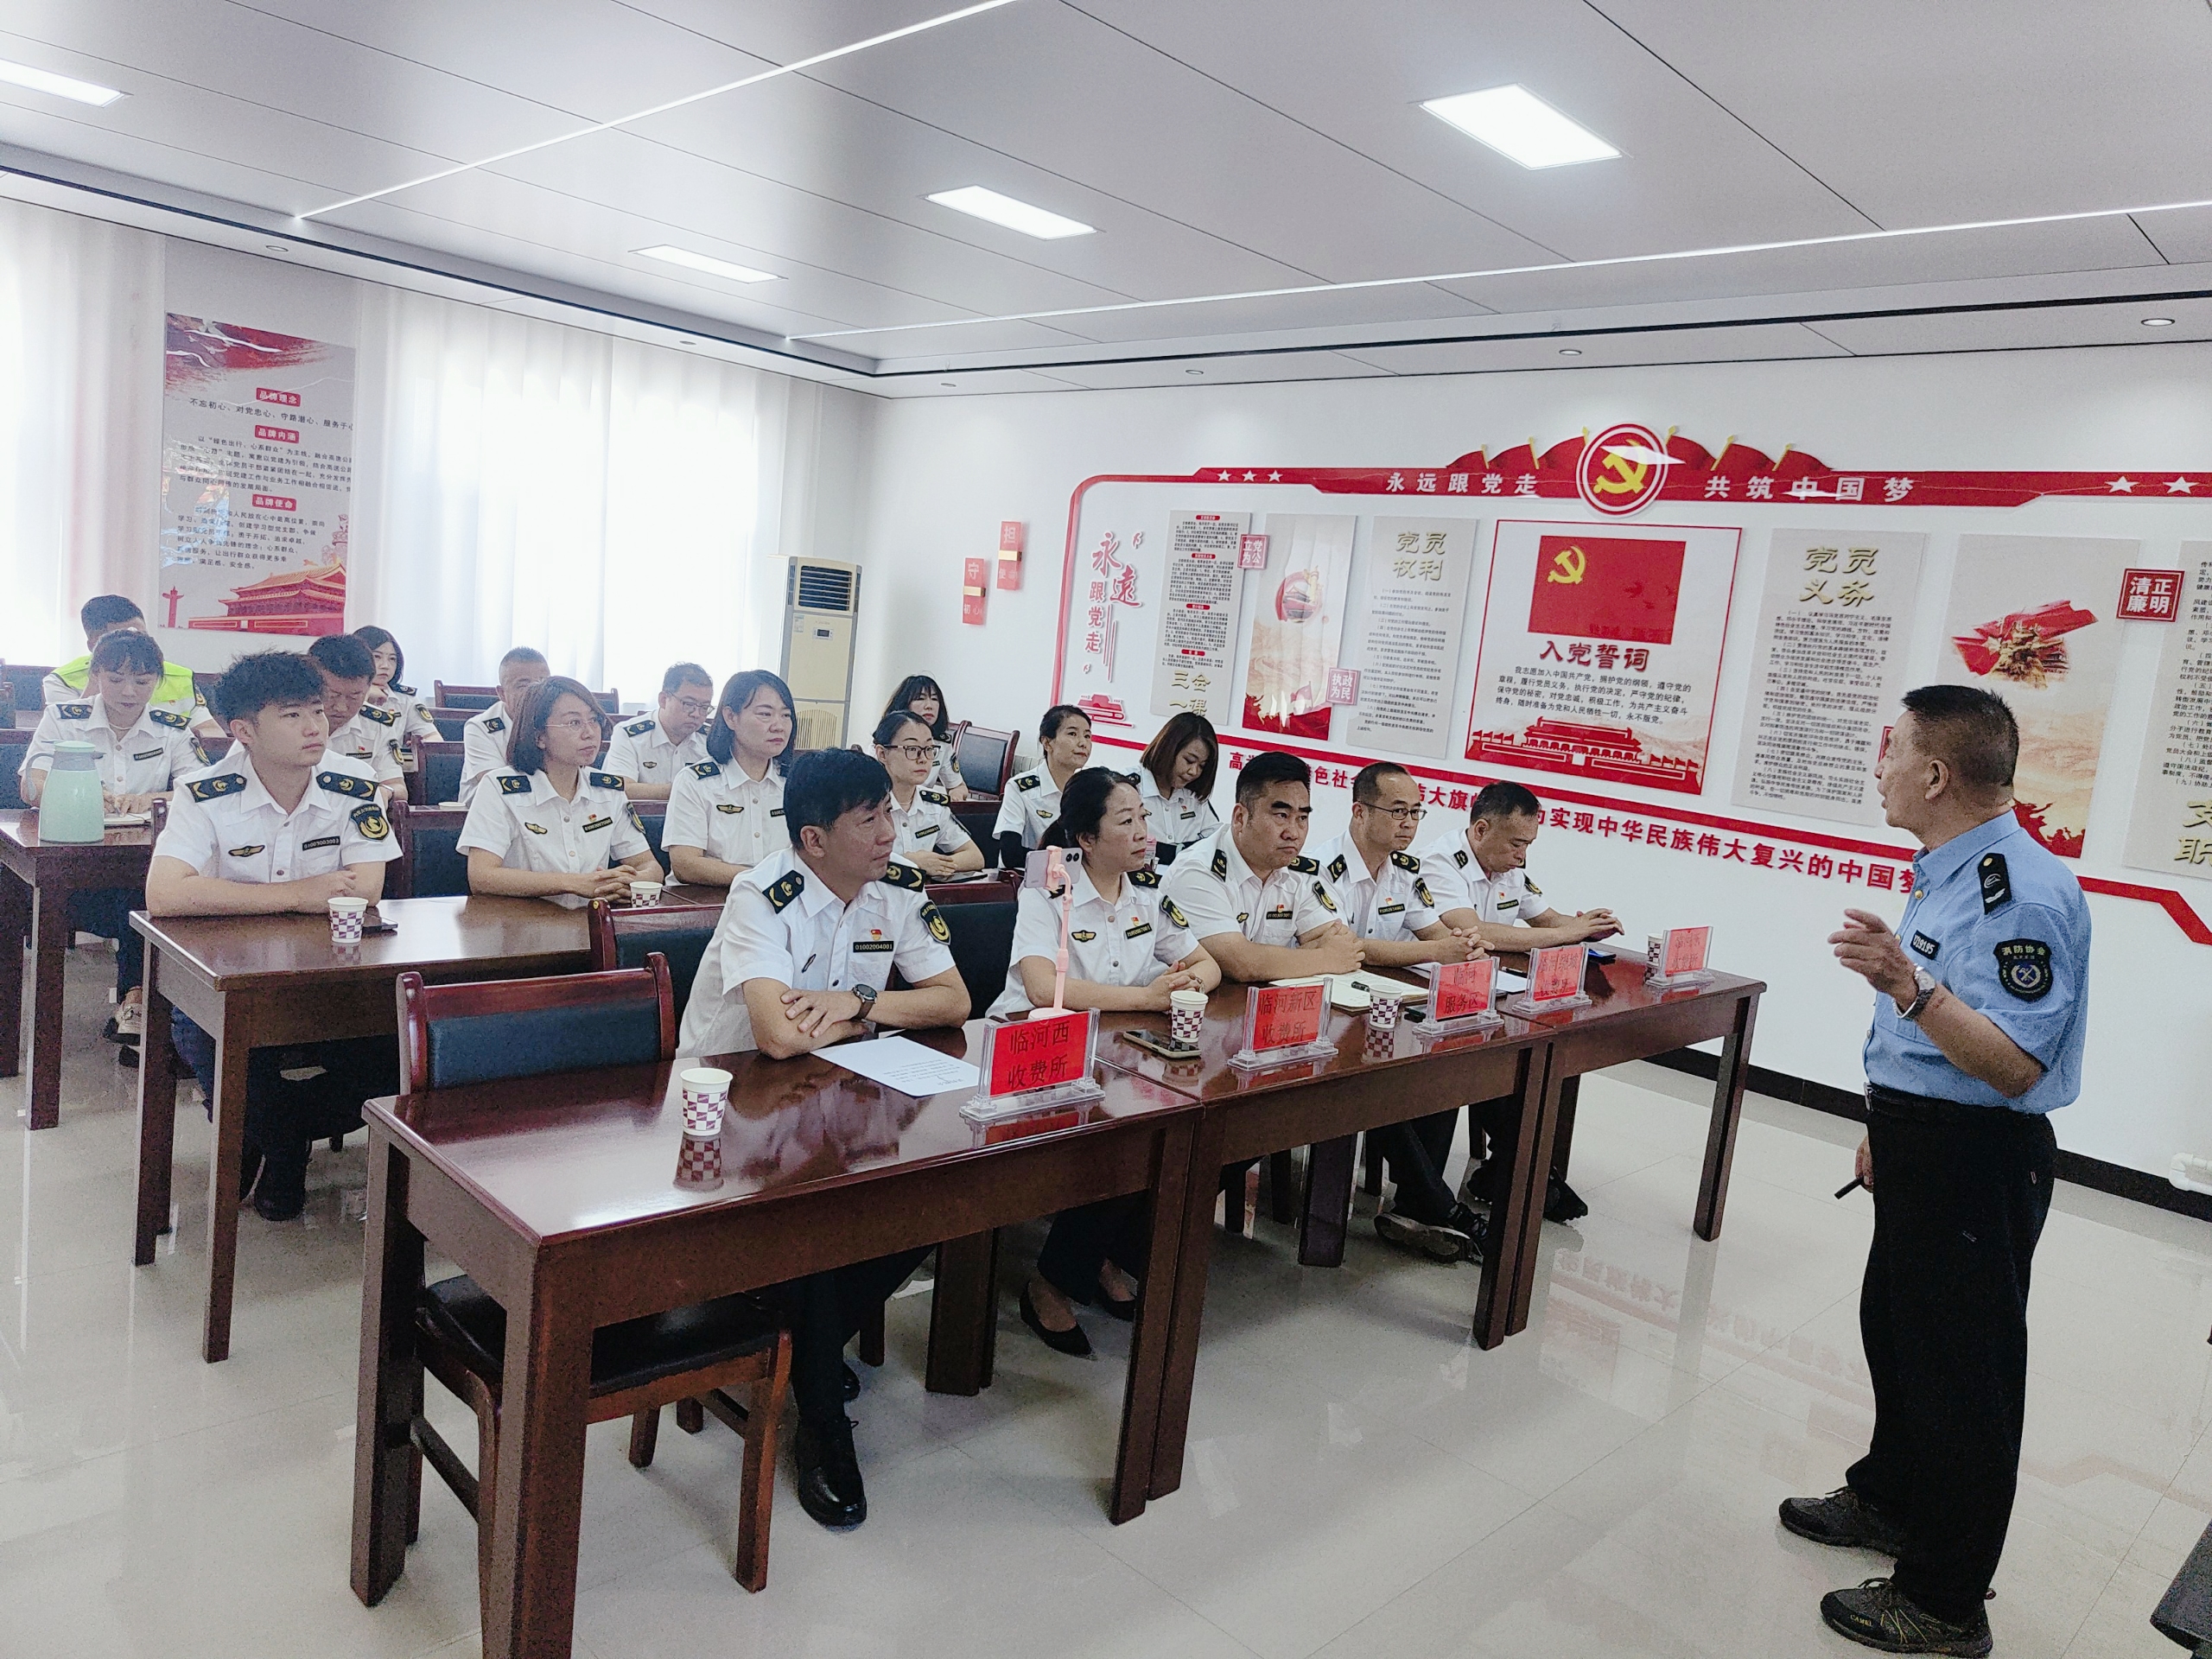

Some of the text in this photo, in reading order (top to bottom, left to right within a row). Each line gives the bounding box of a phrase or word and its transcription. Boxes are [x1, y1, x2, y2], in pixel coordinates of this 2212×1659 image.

[1386, 472, 1537, 494] 永远跟党走
[1704, 475, 1914, 502] 共筑中国梦
[1003, 526, 1016, 543] 担
[1396, 531, 1446, 555] 党员
[968, 563, 979, 580] 守
[1393, 557, 1443, 581] 权利
[1803, 546, 1878, 575] 党员
[1799, 579, 1875, 607] 义务
[1540, 640, 1650, 672] 入党誓词
[1171, 671, 1211, 692] 三会
[1257, 990, 1318, 1016] 临河新区
[1445, 991, 1480, 1014] 服务区
[1009, 1019, 1071, 1056] 临河西
[1262, 1020, 1306, 1045] 收费所
[1007, 1054, 1069, 1090] 收费所
